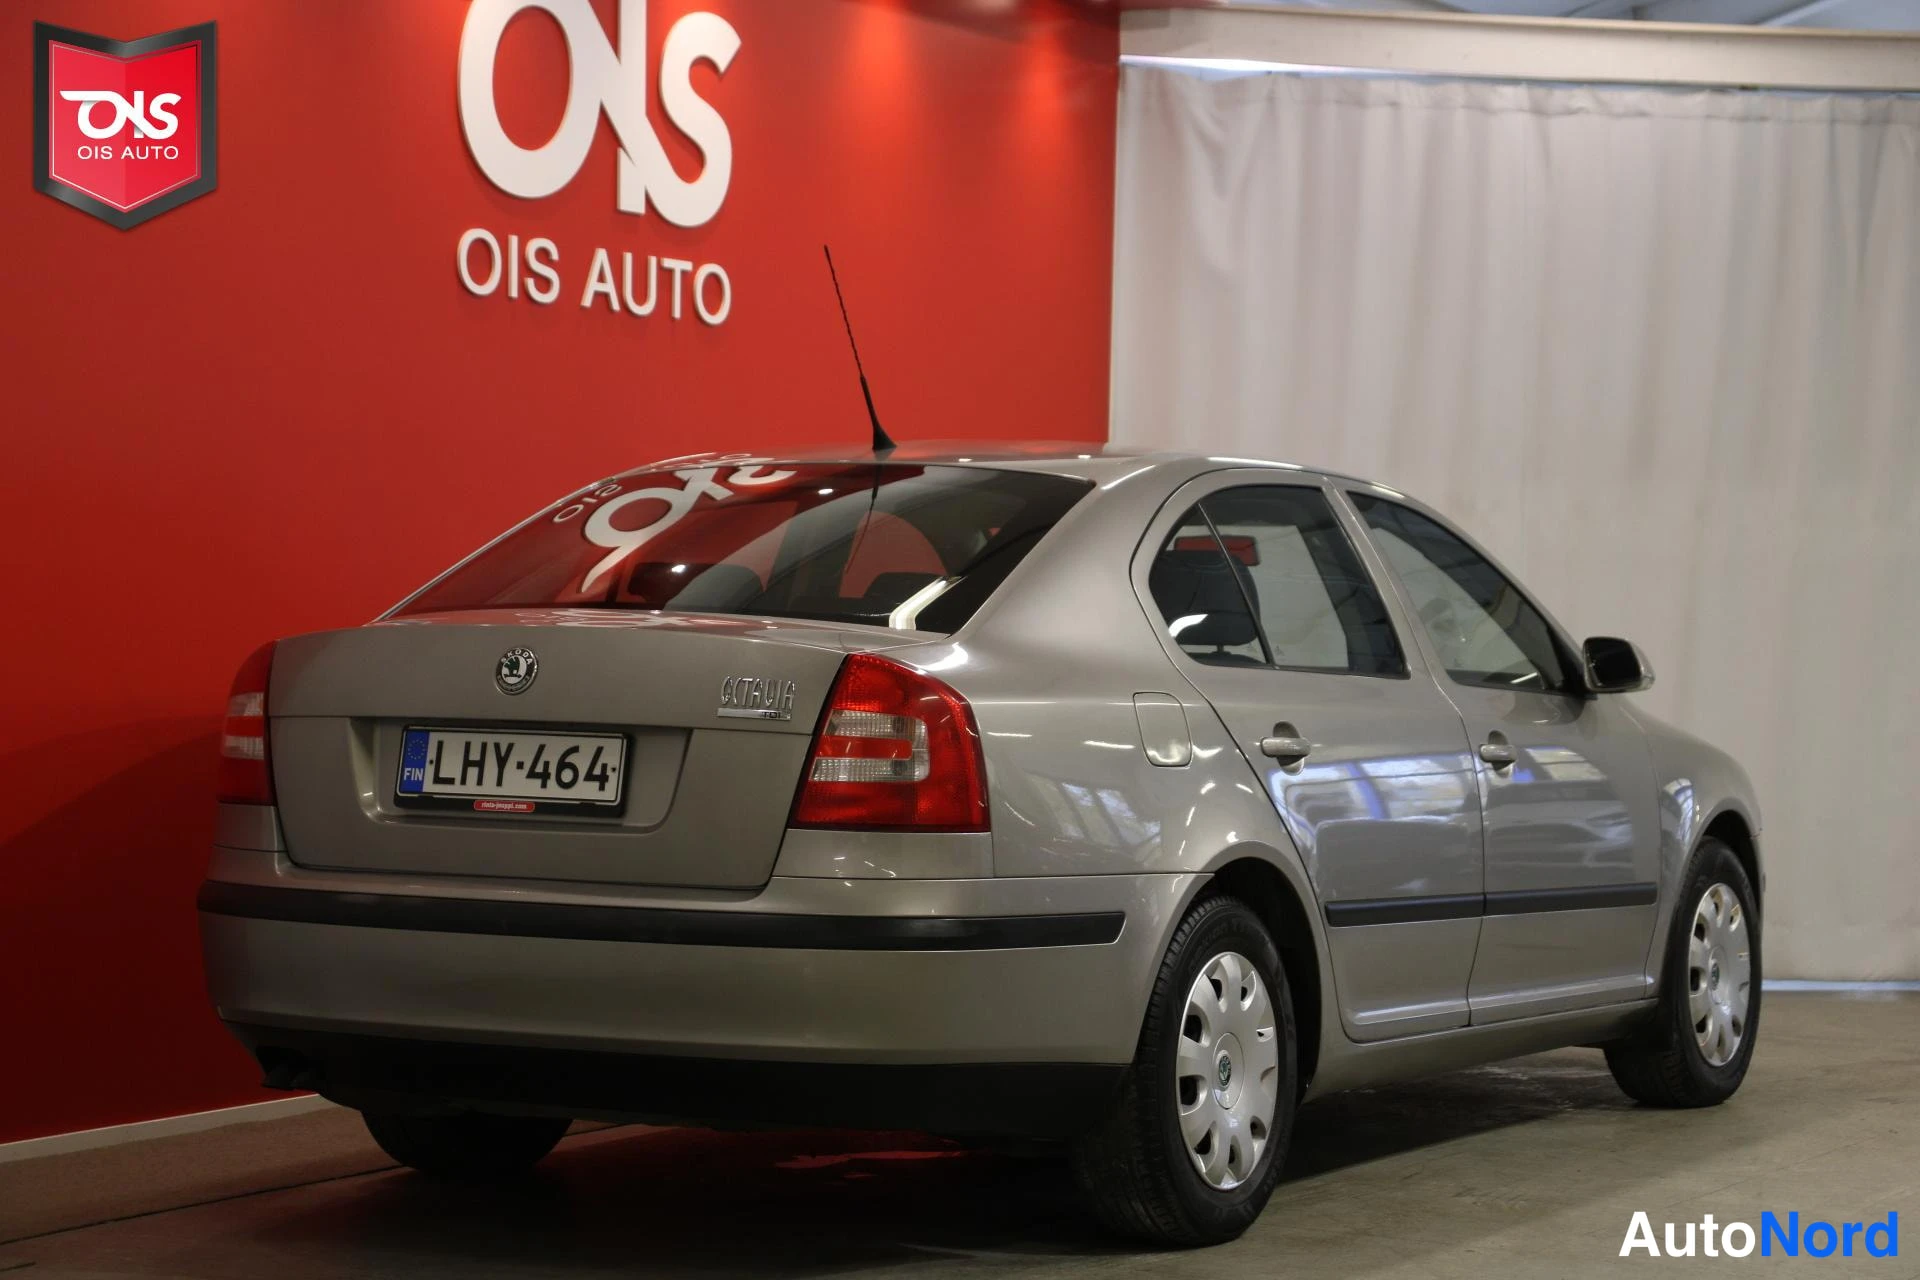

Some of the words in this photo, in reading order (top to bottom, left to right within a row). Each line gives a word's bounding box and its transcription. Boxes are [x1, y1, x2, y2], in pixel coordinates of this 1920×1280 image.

[457, 228, 560, 304] OIS
[580, 247, 731, 326] AUTO
[721, 676, 795, 709] OCTAVIA
[762, 711, 783, 719] TDI
[403, 767, 424, 782] FIN
[432, 740, 610, 791] LHY-464
